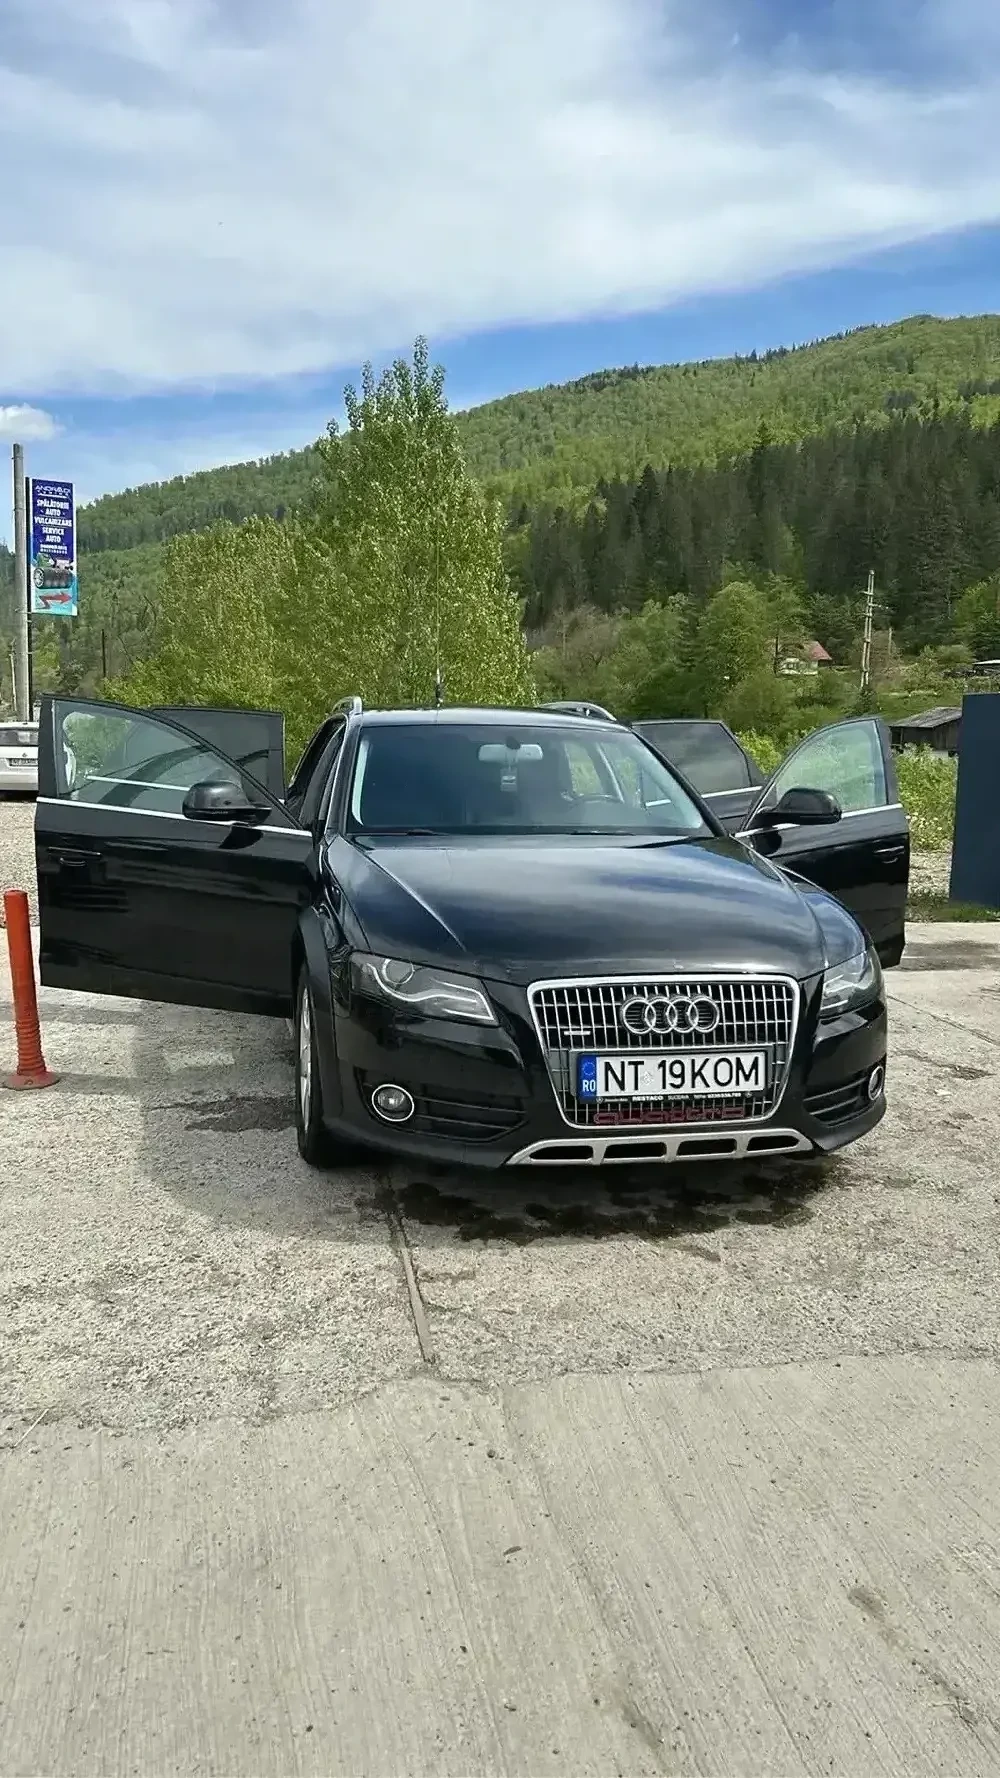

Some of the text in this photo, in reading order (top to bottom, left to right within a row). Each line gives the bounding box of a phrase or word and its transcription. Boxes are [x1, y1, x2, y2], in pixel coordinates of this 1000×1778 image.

[45, 508, 61, 516] AUTO
[42, 527, 64, 535] SERVICE
[604, 1060, 644, 1092] NT
[582, 1079, 596, 1093] RO
